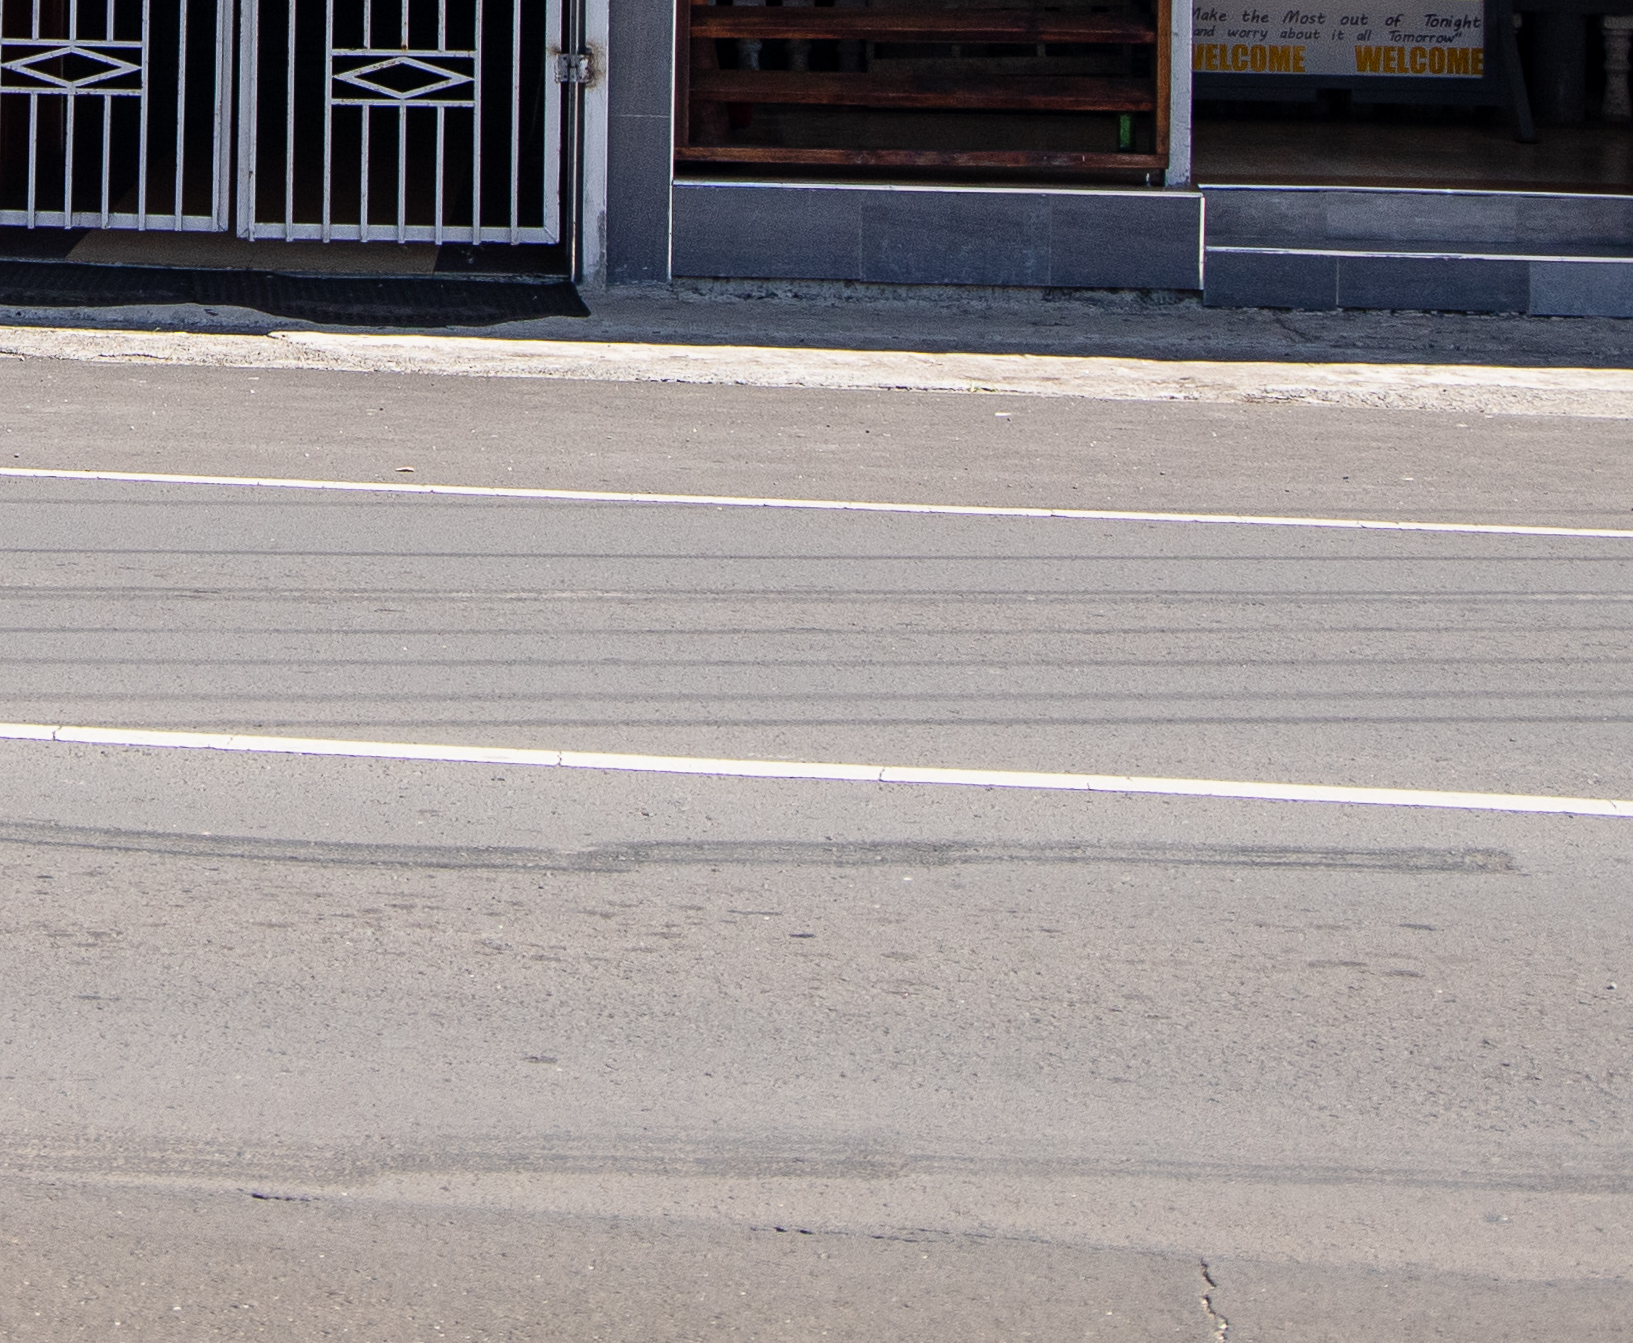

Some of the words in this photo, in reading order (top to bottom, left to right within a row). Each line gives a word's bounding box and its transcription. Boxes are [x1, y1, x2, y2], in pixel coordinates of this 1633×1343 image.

[1242, 9, 1269, 23] the
[1283, 10, 1325, 24] Most
[1340, 14, 1368, 26] out
[1385, 14, 1403, 27] of
[1425, 14, 1481, 31] Tonight
[1194, 25, 1216, 37] and
[1227, 28, 1268, 41] worry
[1280, 28, 1320, 39] about
[1332, 29, 1344, 40] it
[1357, 30, 1372, 41] all
[1355, 45, 1484, 75] WELCOME
